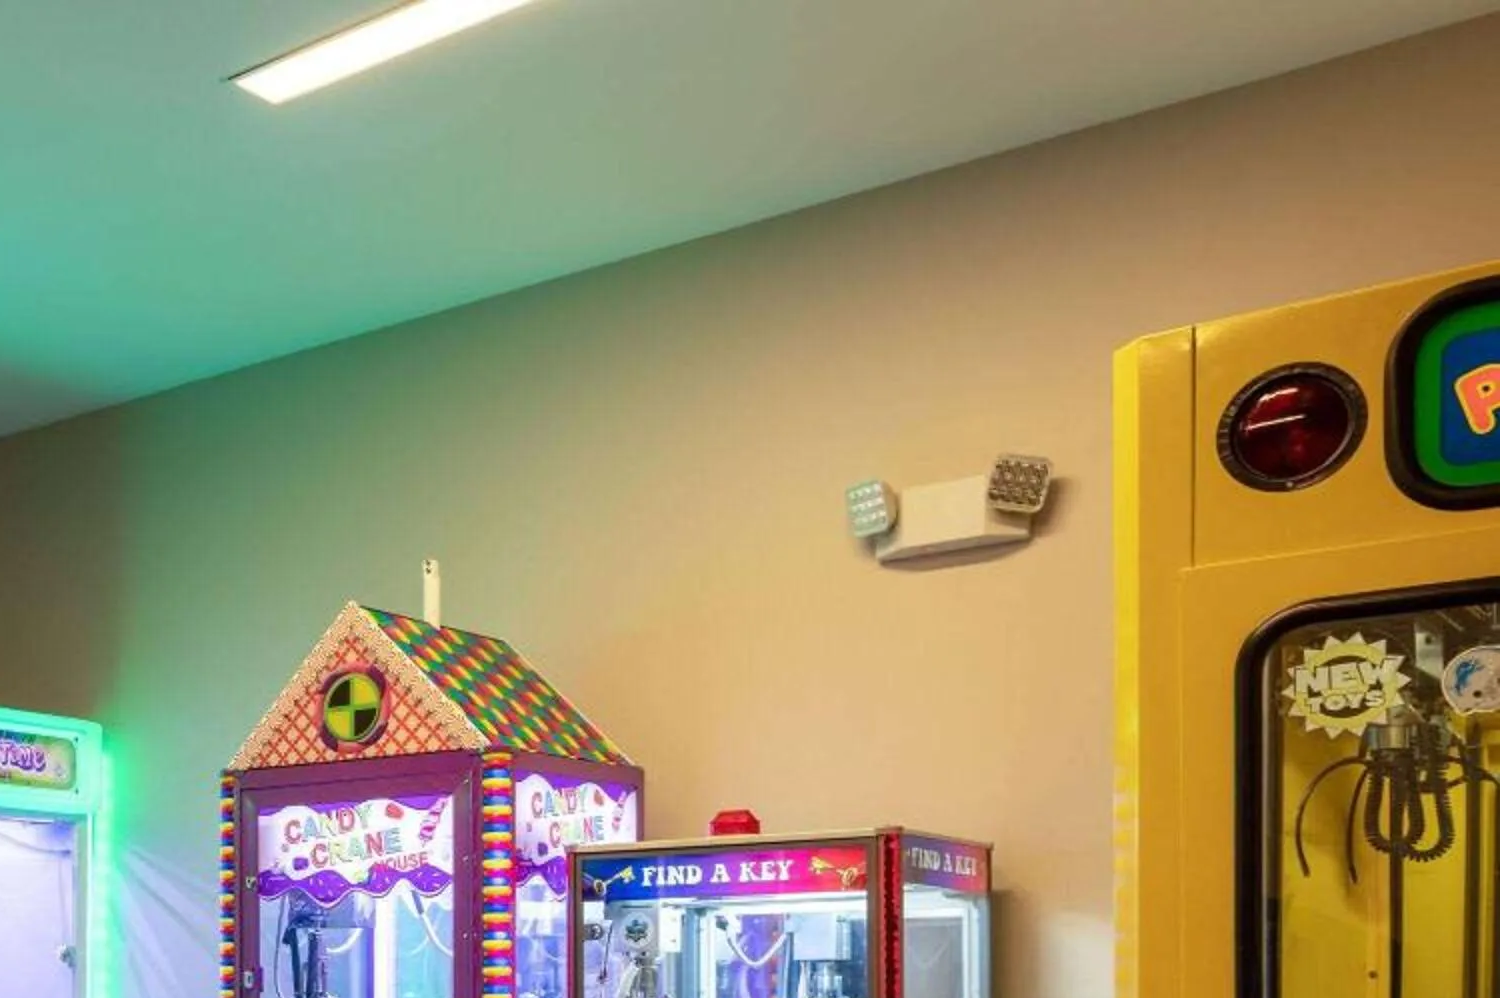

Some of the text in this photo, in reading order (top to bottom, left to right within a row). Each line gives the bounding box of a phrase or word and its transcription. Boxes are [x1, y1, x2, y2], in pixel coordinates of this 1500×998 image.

[1295, 655, 1404, 694] NEW
[1304, 689, 1385, 714] TOYS
[284, 803, 373, 844] CANDY
[311, 827, 403, 868] CRANE
[373, 851, 429, 872] HOUSE
[641, 859, 795, 888] FIND A KEY
[943, 853, 953, 873] A
